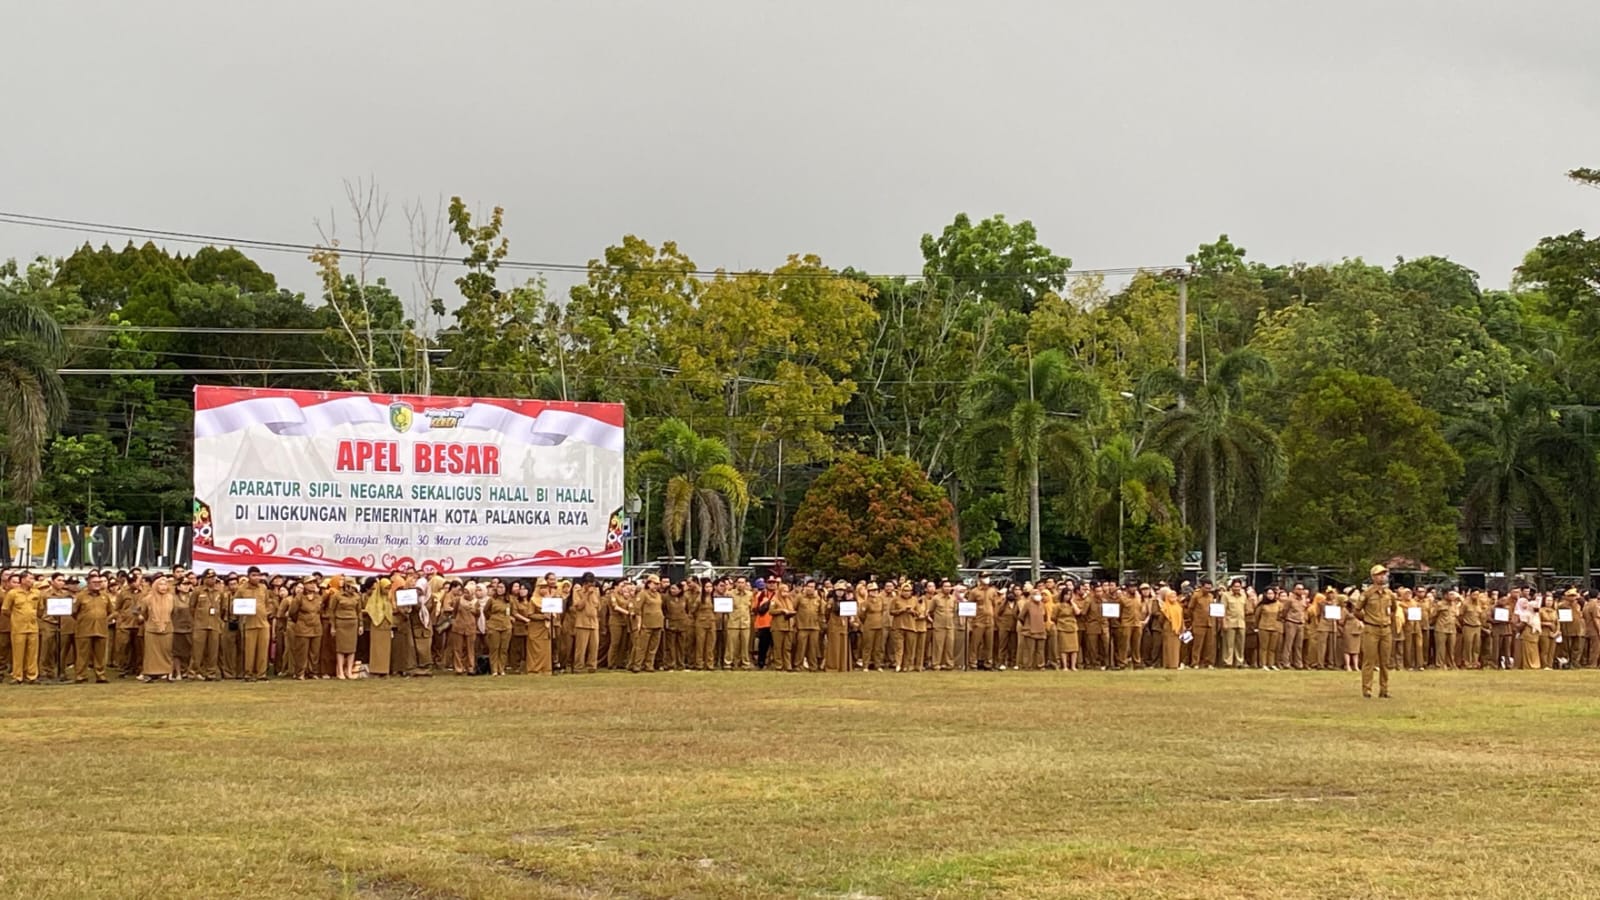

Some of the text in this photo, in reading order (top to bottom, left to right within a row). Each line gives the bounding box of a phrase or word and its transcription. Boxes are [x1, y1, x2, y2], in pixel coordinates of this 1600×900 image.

[336, 440, 499, 475] APEL BESAR
[228, 480, 595, 503] APARATUR SIPIL NEGARA SEKALIGUS HALAL BI HALAL
[235, 504, 589, 526] DI LINGKUNGAN PEMERINTAH KOTA PALANGKA RAYA
[334, 533, 378, 547] Palangka
[417, 534, 430, 546] 30
[435, 534, 462, 546] Maret
[465, 535, 489, 546] 2026
